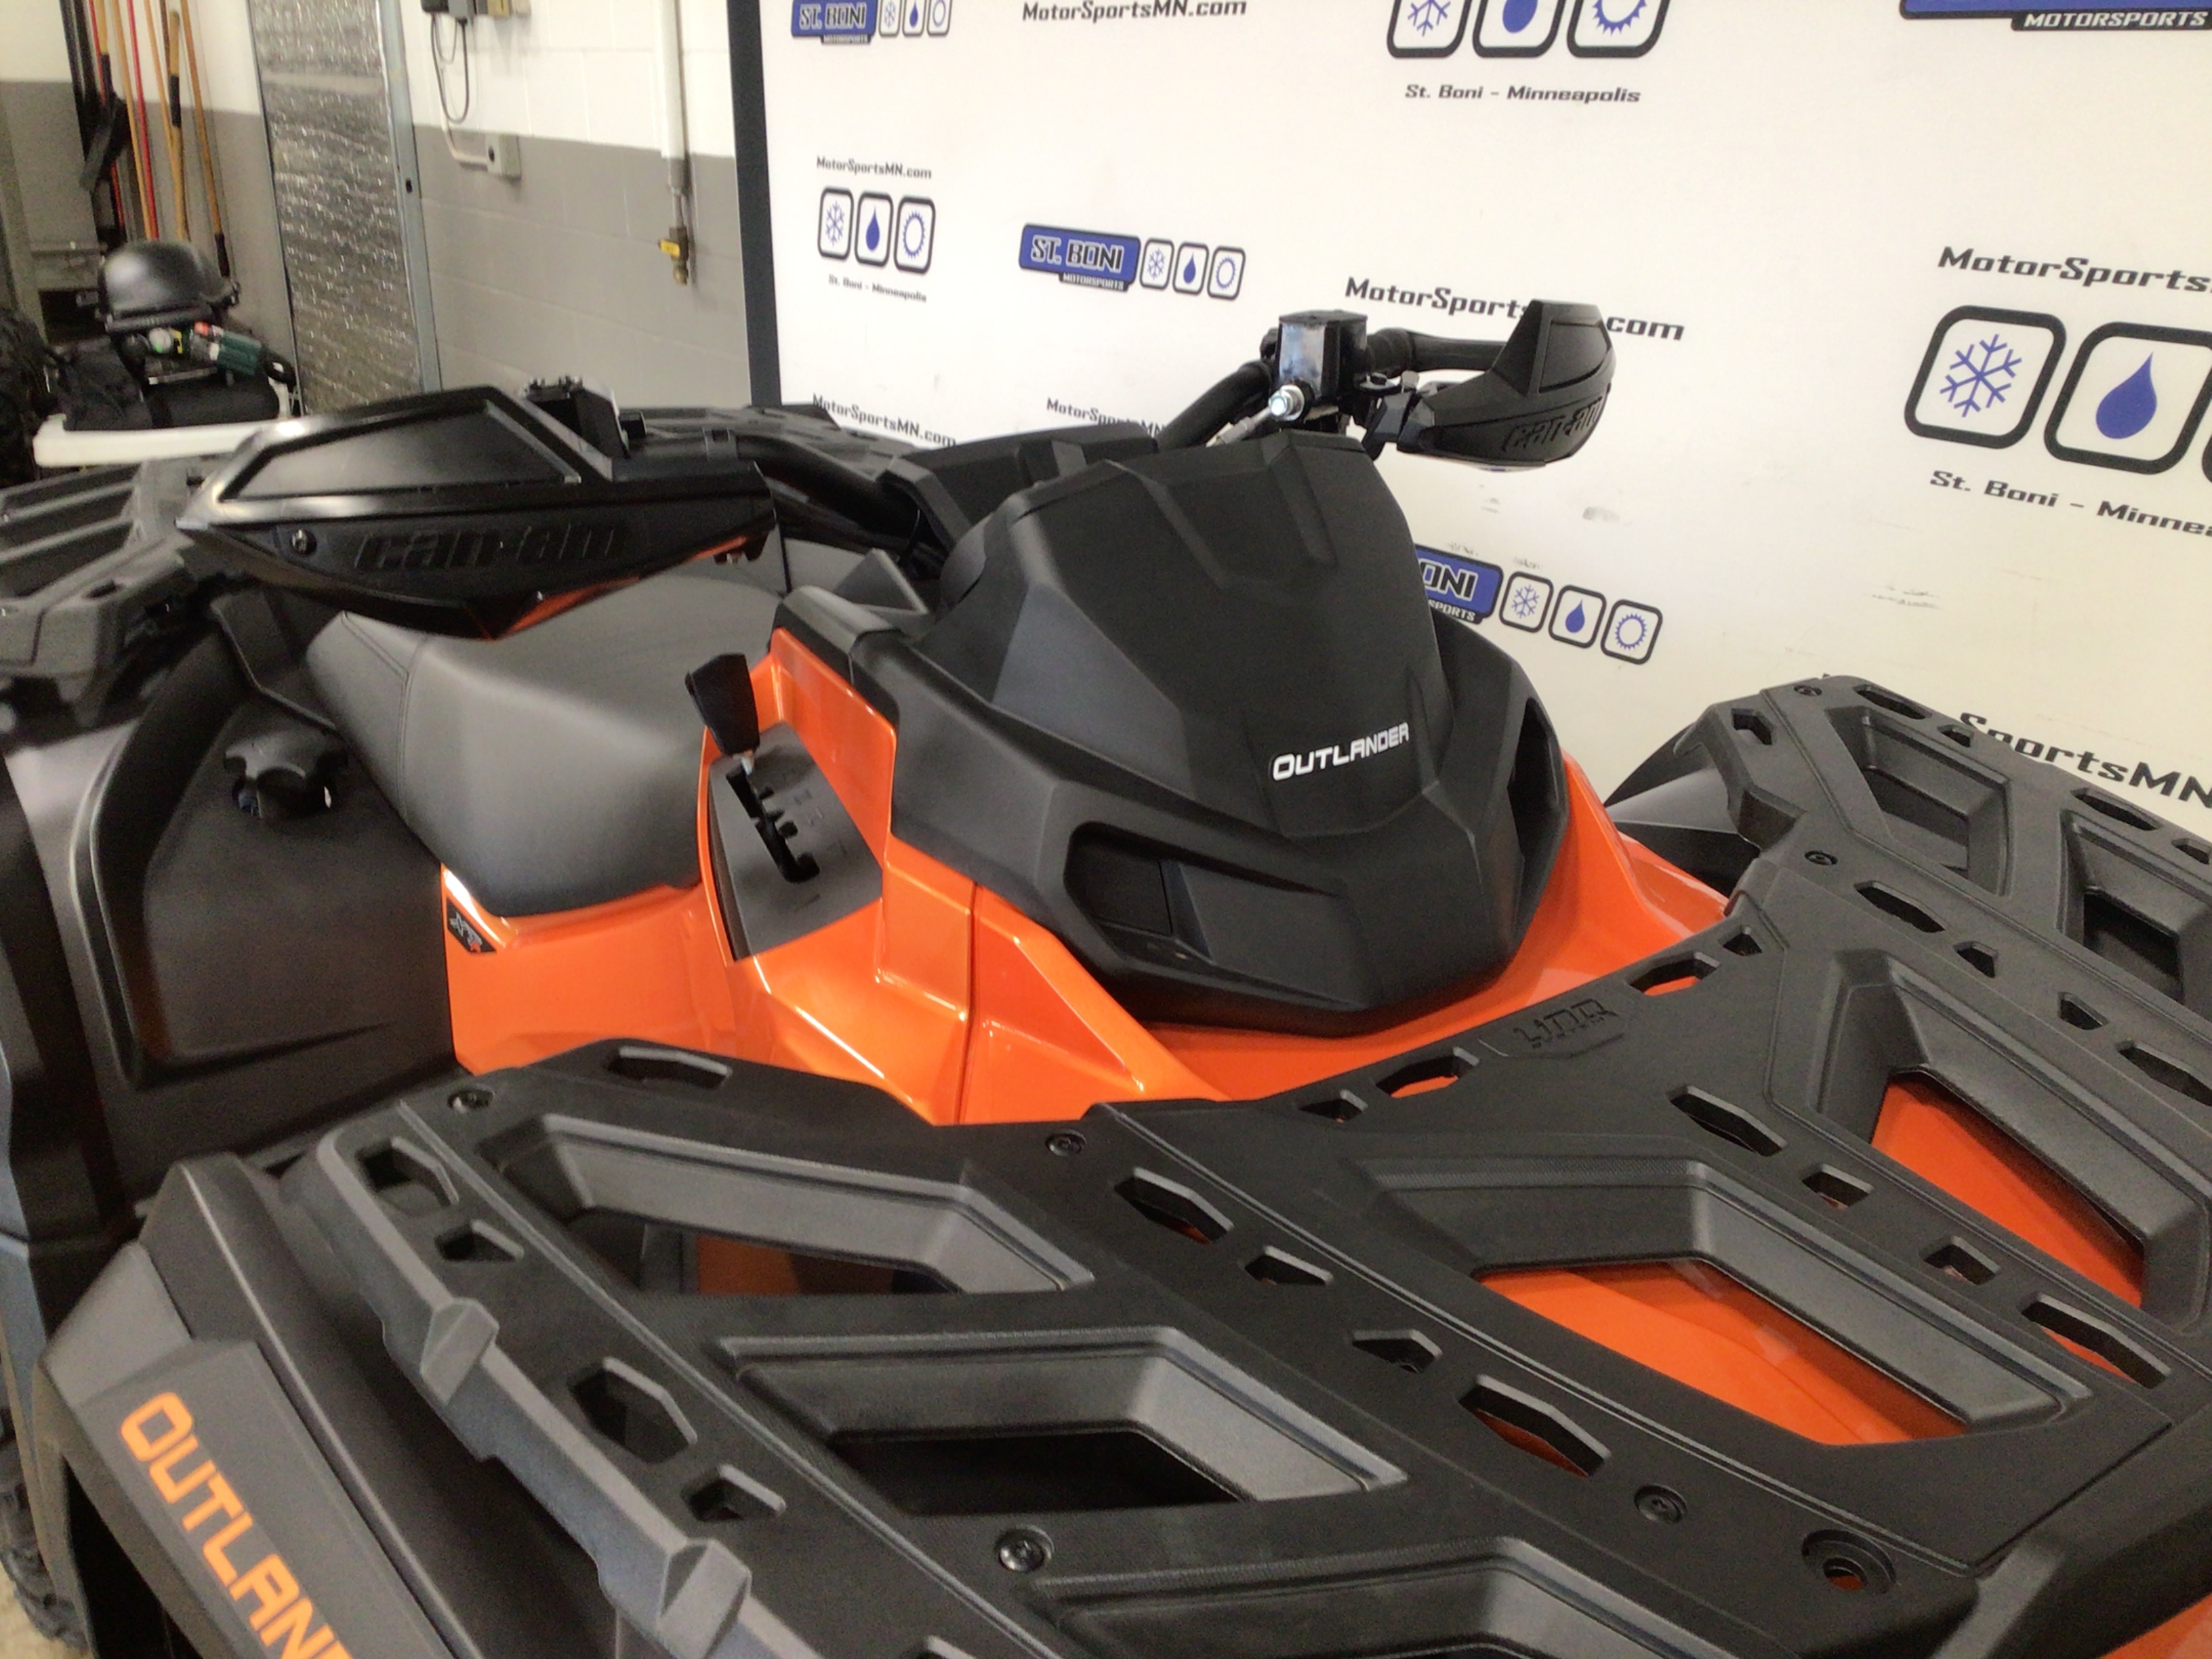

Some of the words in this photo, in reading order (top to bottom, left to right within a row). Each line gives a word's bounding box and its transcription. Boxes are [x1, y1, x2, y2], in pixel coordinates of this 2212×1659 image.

[825, 3, 867, 29] BONI
[1023, 0, 1247, 24] MotorSportsMN.com
[2024, 12, 2208, 26] MOTORSPORTS
[1405, 84, 1431, 98] St.
[1438, 84, 1483, 99] Boni
[1507, 85, 1641, 104] Minneapolis
[817, 156, 933, 180] MotorSportsMN.com
[1031, 234, 1062, 265] ST.
[1066, 239, 1125, 274] BONI
[1938, 246, 2212, 293] MotorSports
[1063, 272, 1125, 291] MOTORSPORTS
[1930, 470, 1971, 491] St.
[1984, 480, 2059, 507] Boni
[1419, 558, 1479, 602] ONI
[1273, 721, 1410, 781] OUTLANDER
[120, 1391, 354, 1659] OUTLAN
